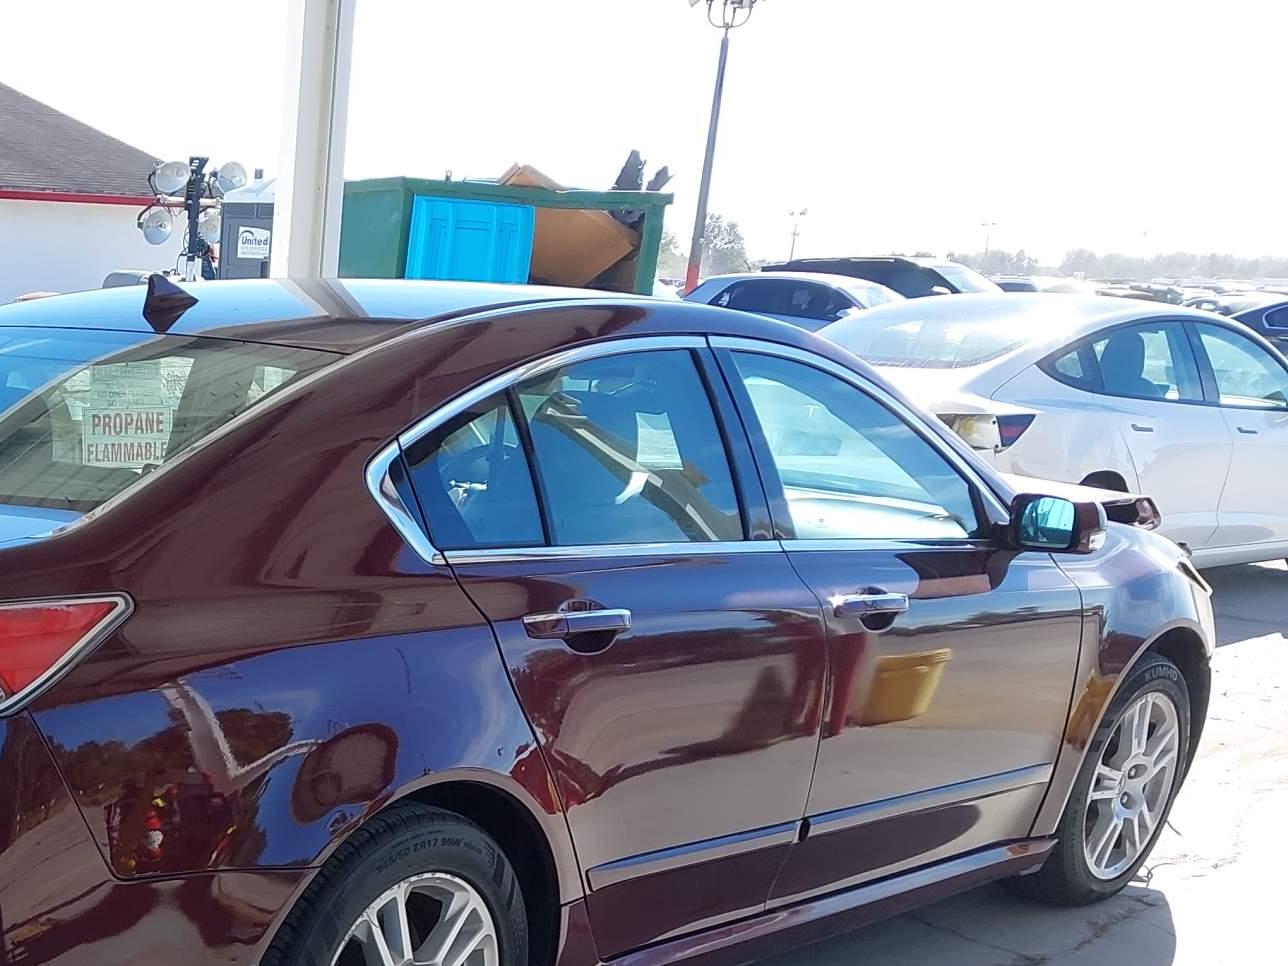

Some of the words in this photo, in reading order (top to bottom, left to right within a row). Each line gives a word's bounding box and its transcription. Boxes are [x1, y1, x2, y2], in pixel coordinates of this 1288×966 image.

[241, 235, 268, 246] United
[92, 412, 164, 436] PROPANE
[87, 442, 167, 463] FLAMMABLE
[1144, 665, 1178, 681] KUMHO
